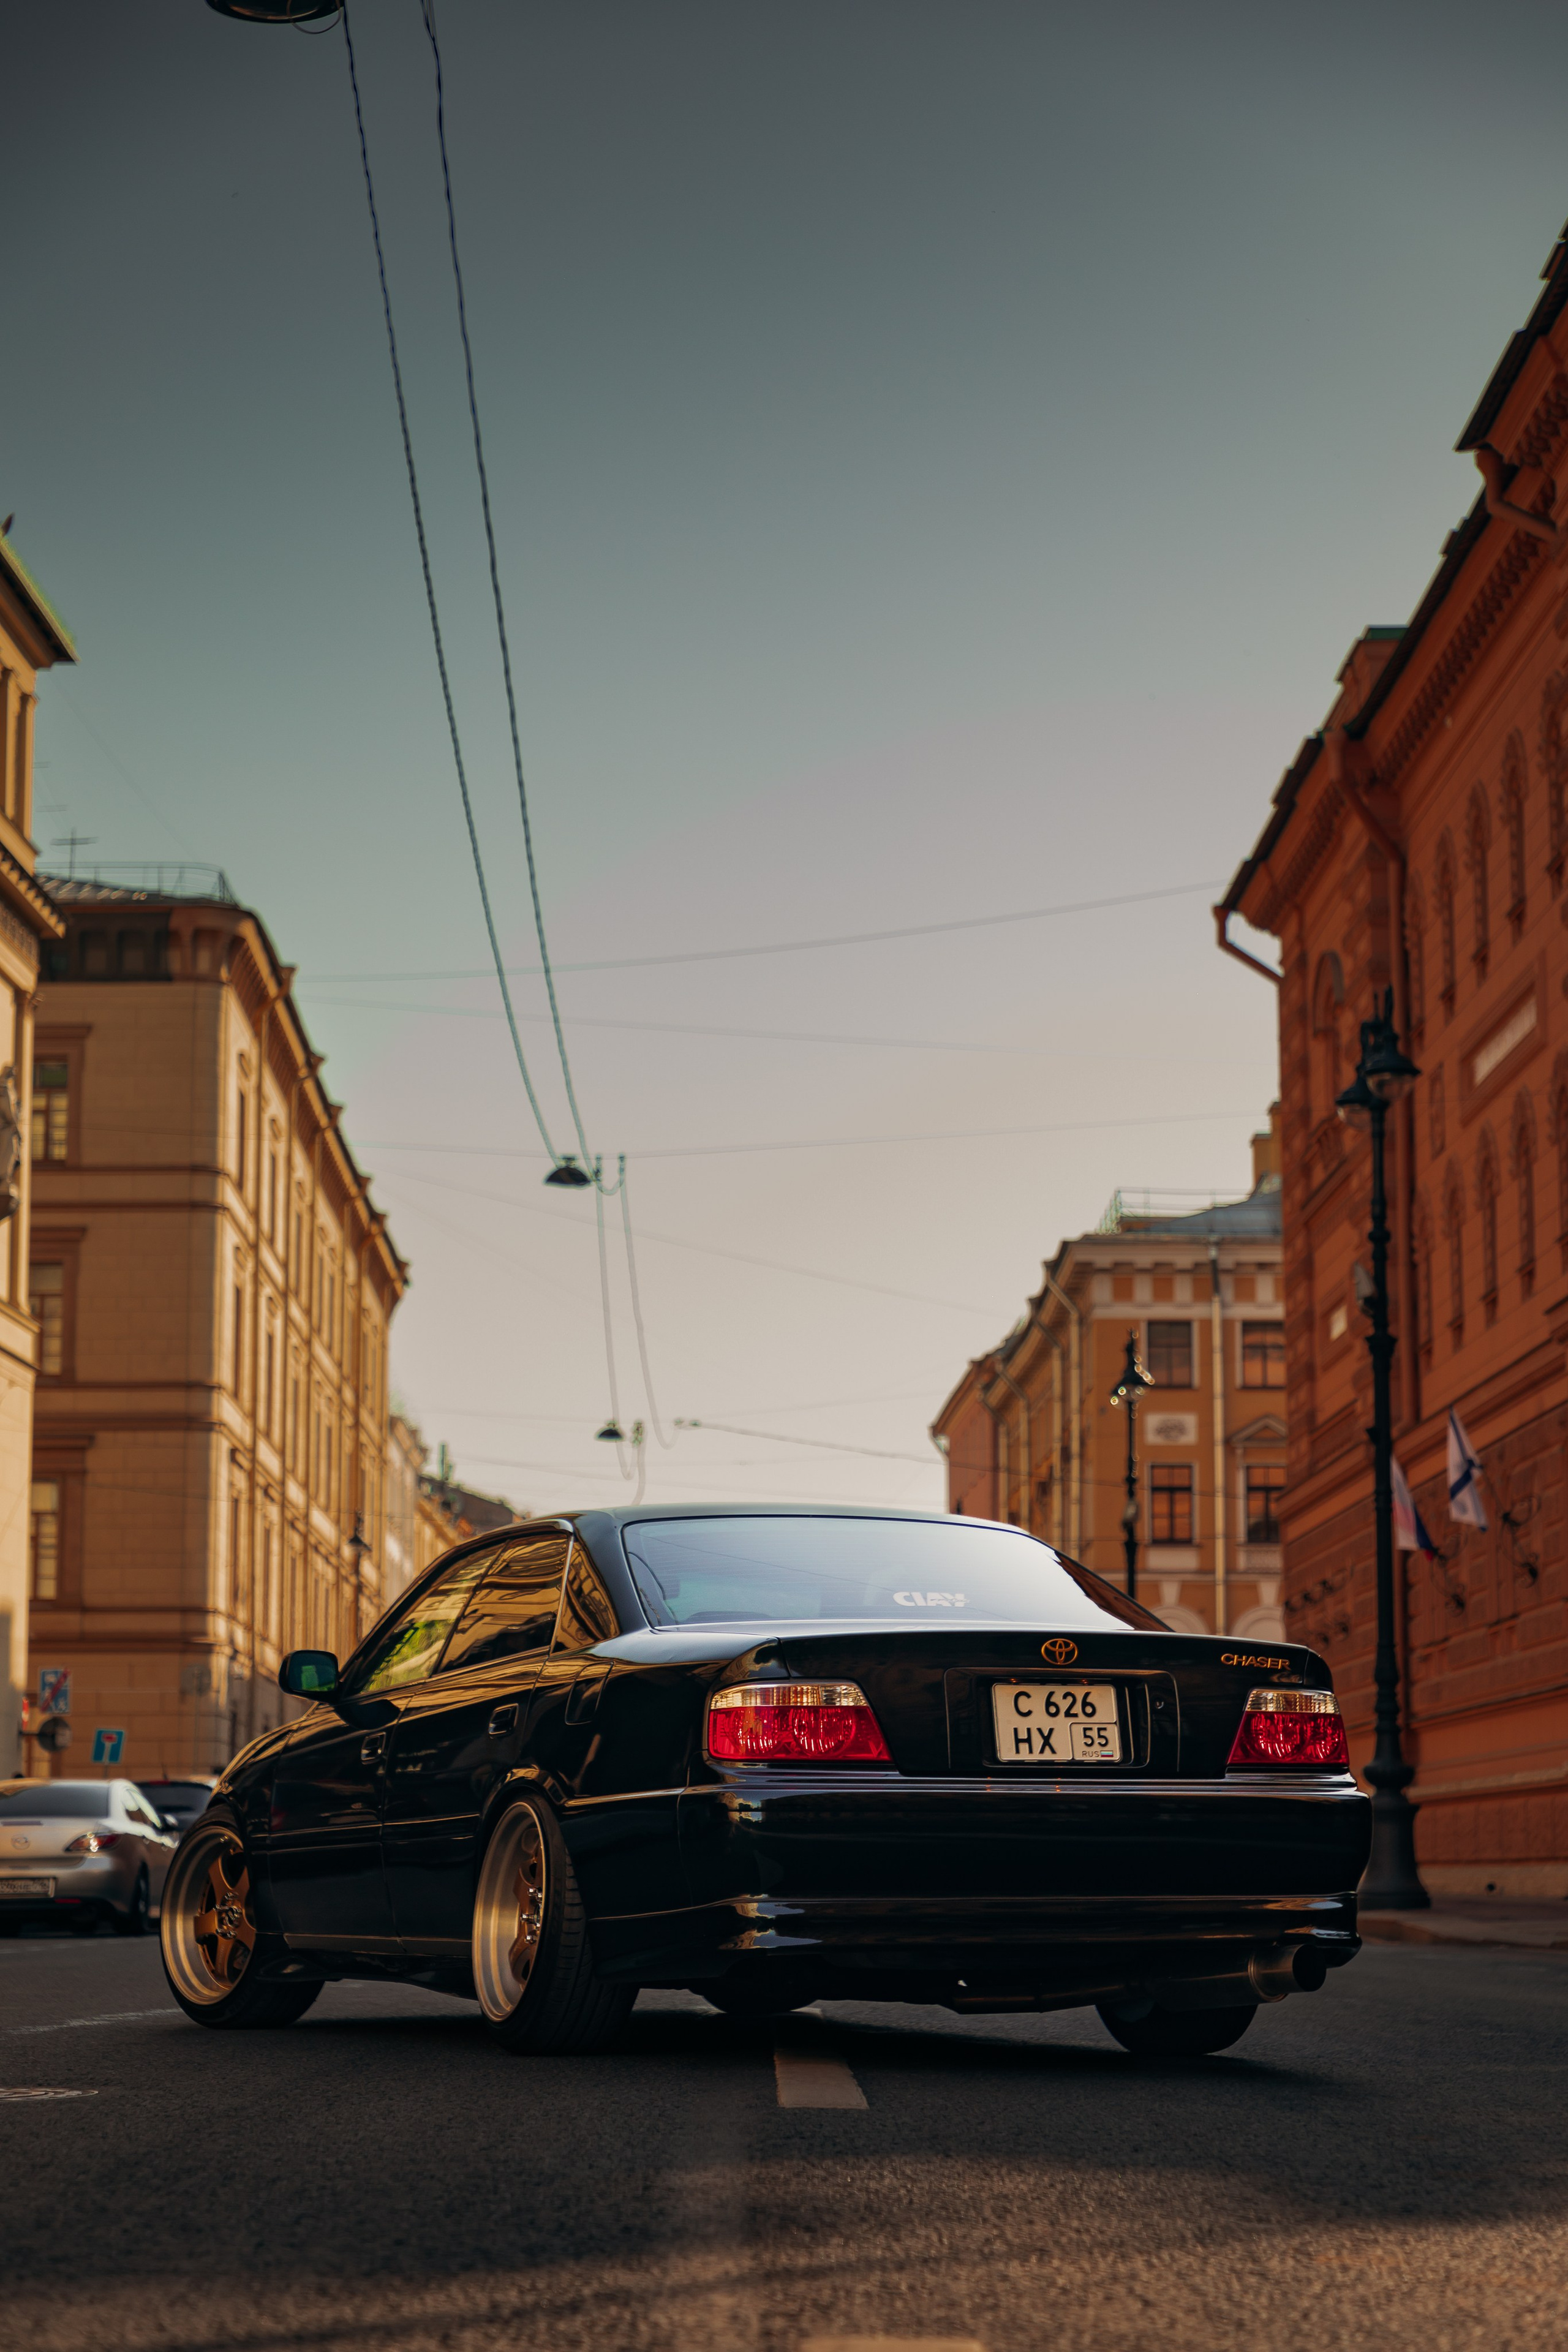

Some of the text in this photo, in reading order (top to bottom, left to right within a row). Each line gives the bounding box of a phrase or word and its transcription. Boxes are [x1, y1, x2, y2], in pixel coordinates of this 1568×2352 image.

[1221, 1653, 1292, 1671] CHASER
[1014, 1691, 1096, 1718] C 626
[1012, 1727, 1057, 1755] HX
[1082, 1727, 1109, 1747] 55
